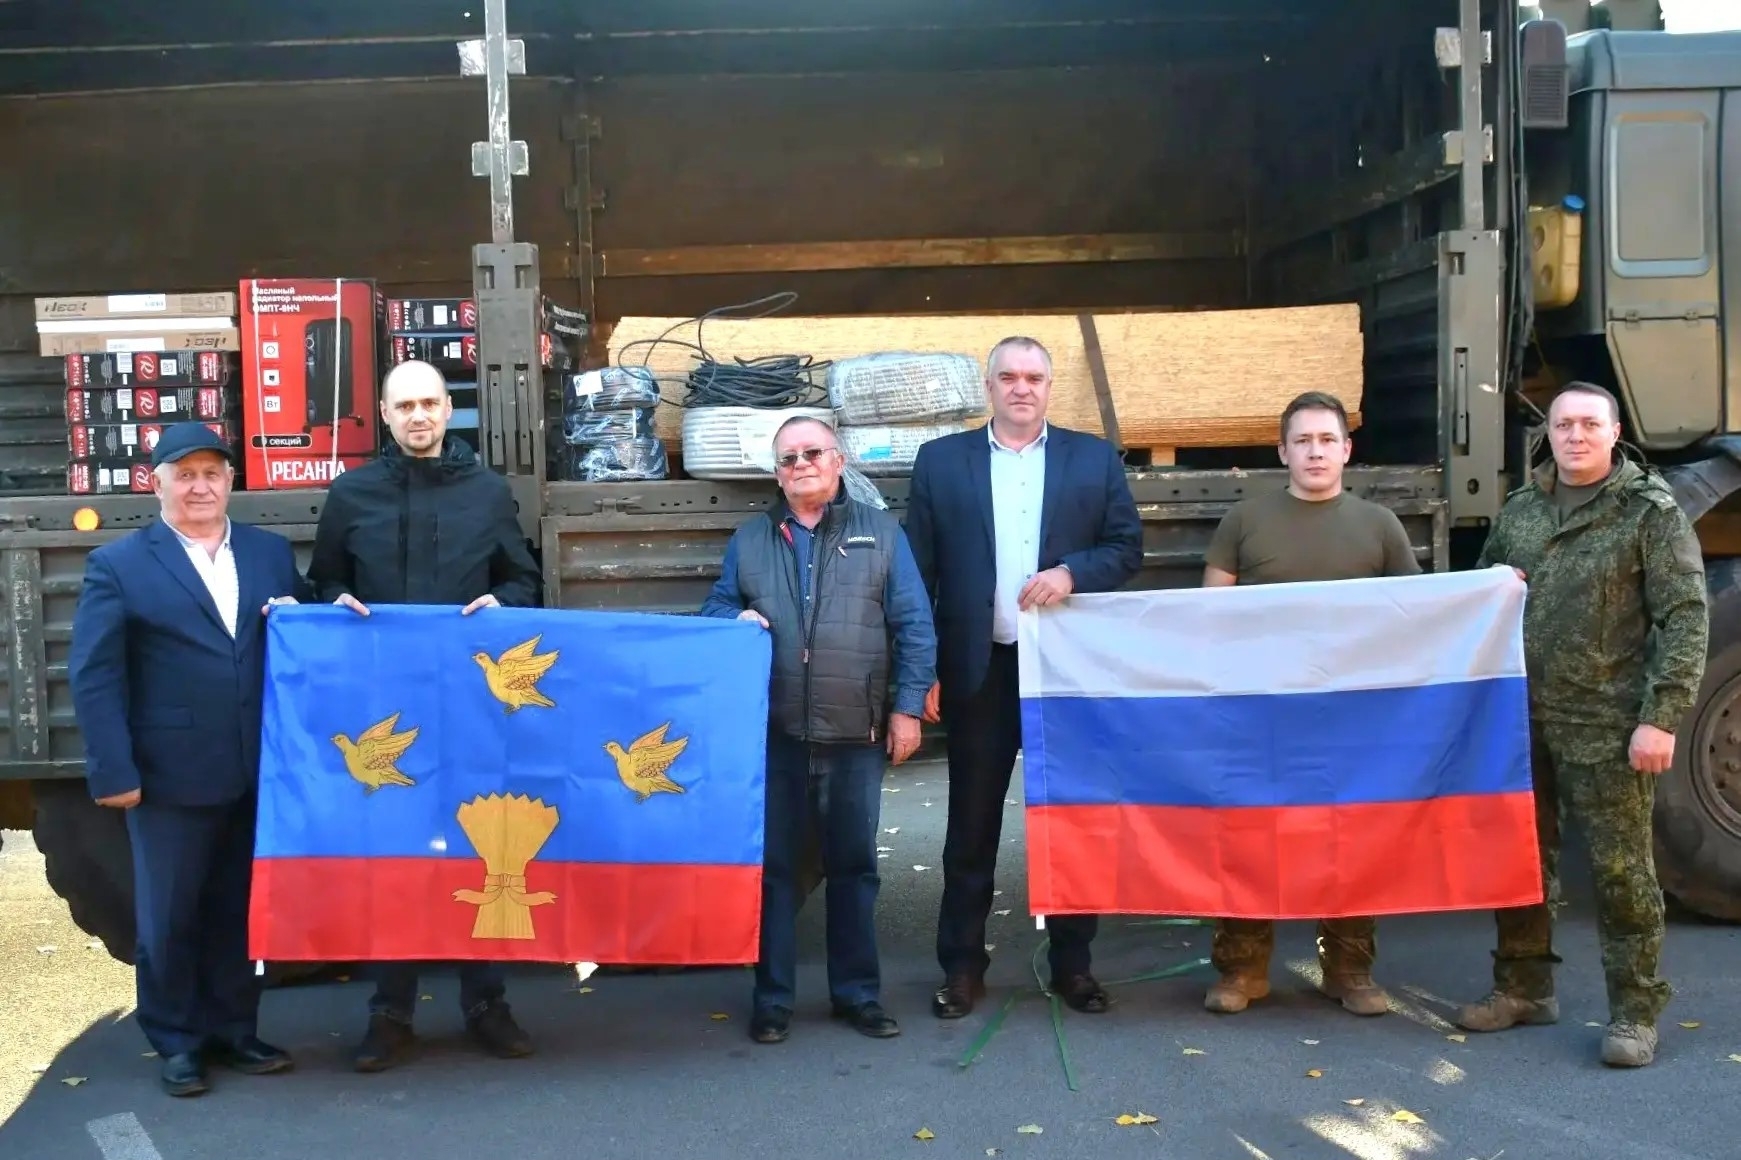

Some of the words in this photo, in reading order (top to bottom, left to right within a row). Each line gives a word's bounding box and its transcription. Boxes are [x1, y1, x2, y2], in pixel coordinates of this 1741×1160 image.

[292, 294, 339, 302] напольный
[269, 437, 302, 446] секций
[272, 460, 346, 481] РЕСАНТА
